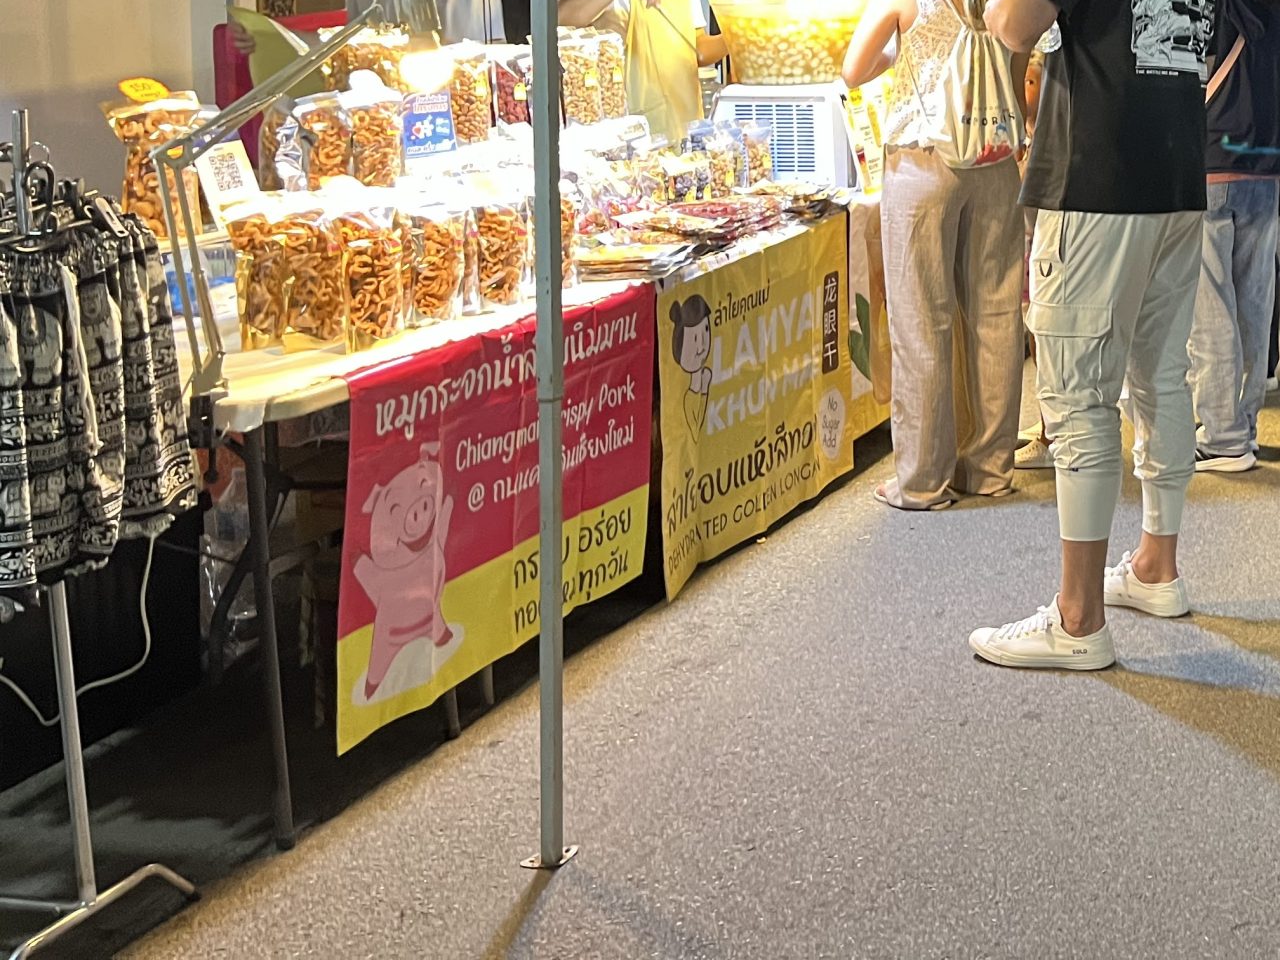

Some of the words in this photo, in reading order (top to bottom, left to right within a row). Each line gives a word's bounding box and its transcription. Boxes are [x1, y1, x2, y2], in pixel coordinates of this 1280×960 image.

[712, 286, 822, 385] LAMYAI
[455, 411, 541, 472] Chiangmai
[560, 397, 595, 431] rispy
[598, 373, 636, 413] Pork
[706, 370, 778, 436] KHUN
[827, 395, 838, 412] No
[468, 482, 486, 512] @
[578, 506, 632, 553] อร่อย
